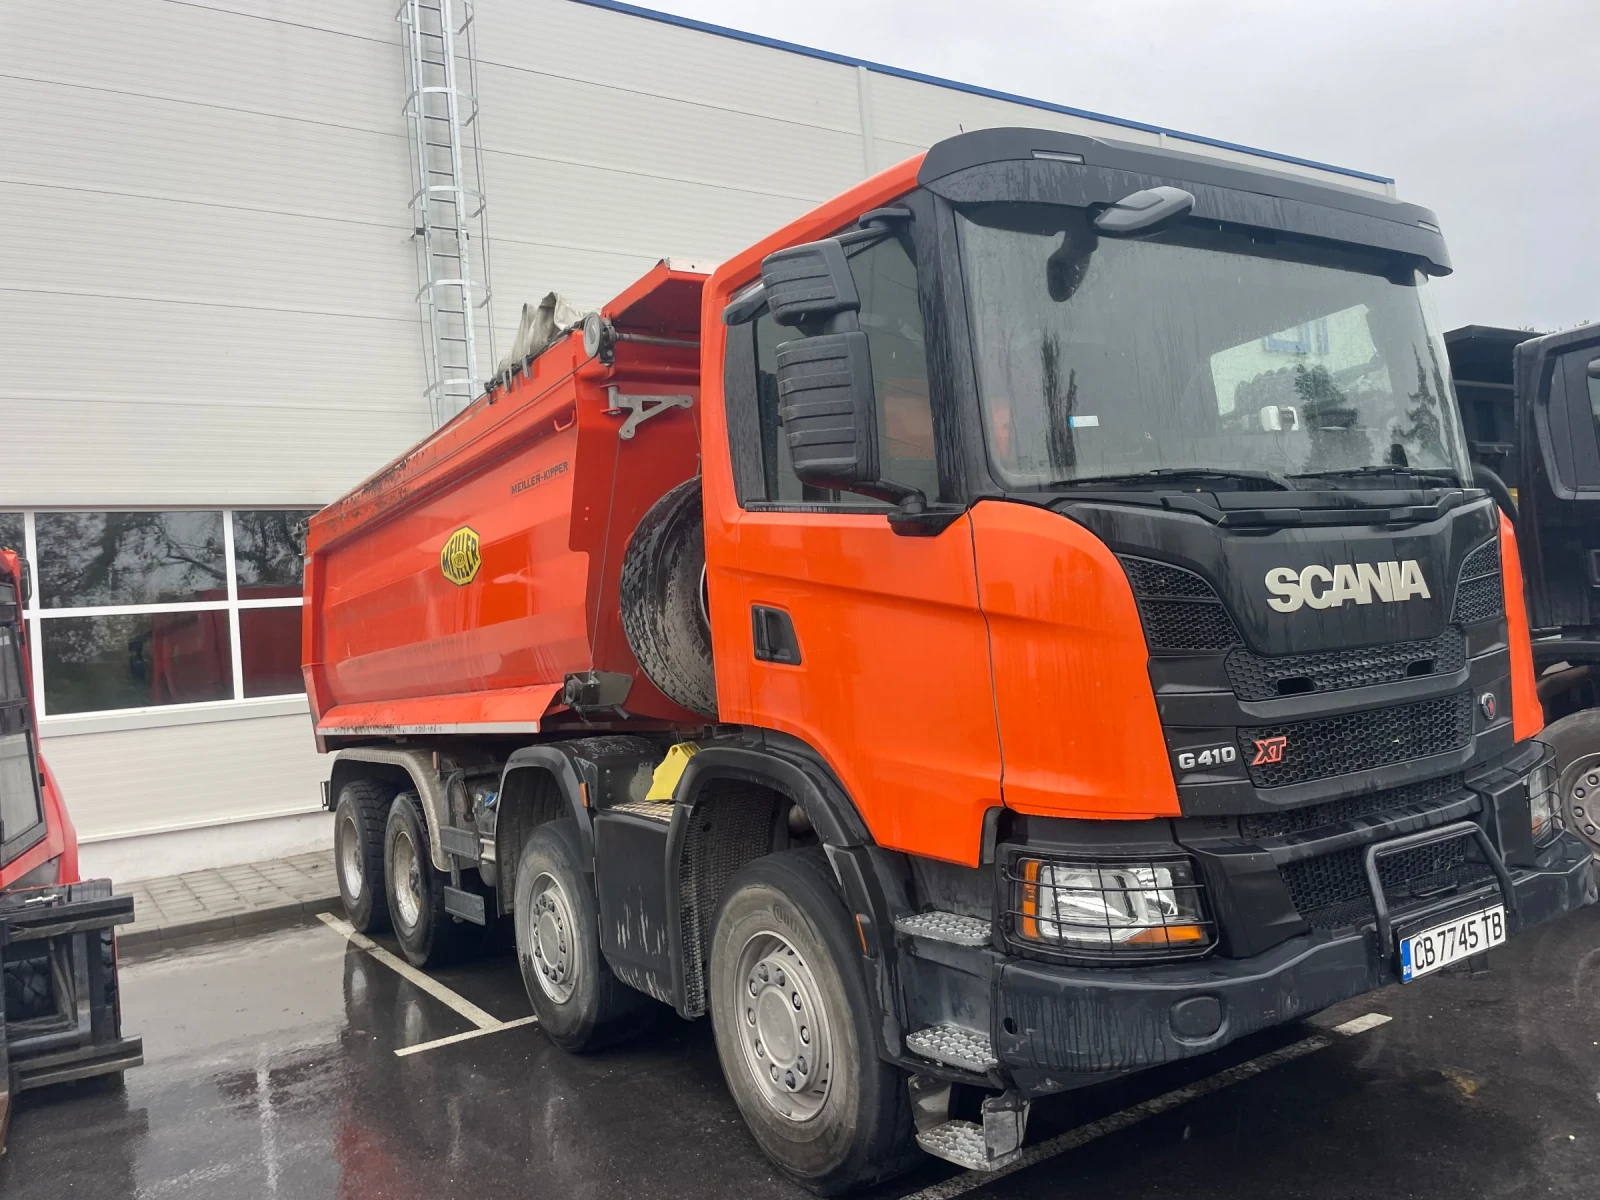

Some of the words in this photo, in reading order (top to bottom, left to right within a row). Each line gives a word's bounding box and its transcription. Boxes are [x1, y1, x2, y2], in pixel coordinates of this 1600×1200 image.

[511, 461, 569, 495] MEILLER-KIPPER
[1265, 559, 1431, 613] SCANIA
[1251, 736, 1287, 766] XT
[1403, 964, 1411, 976] BG
